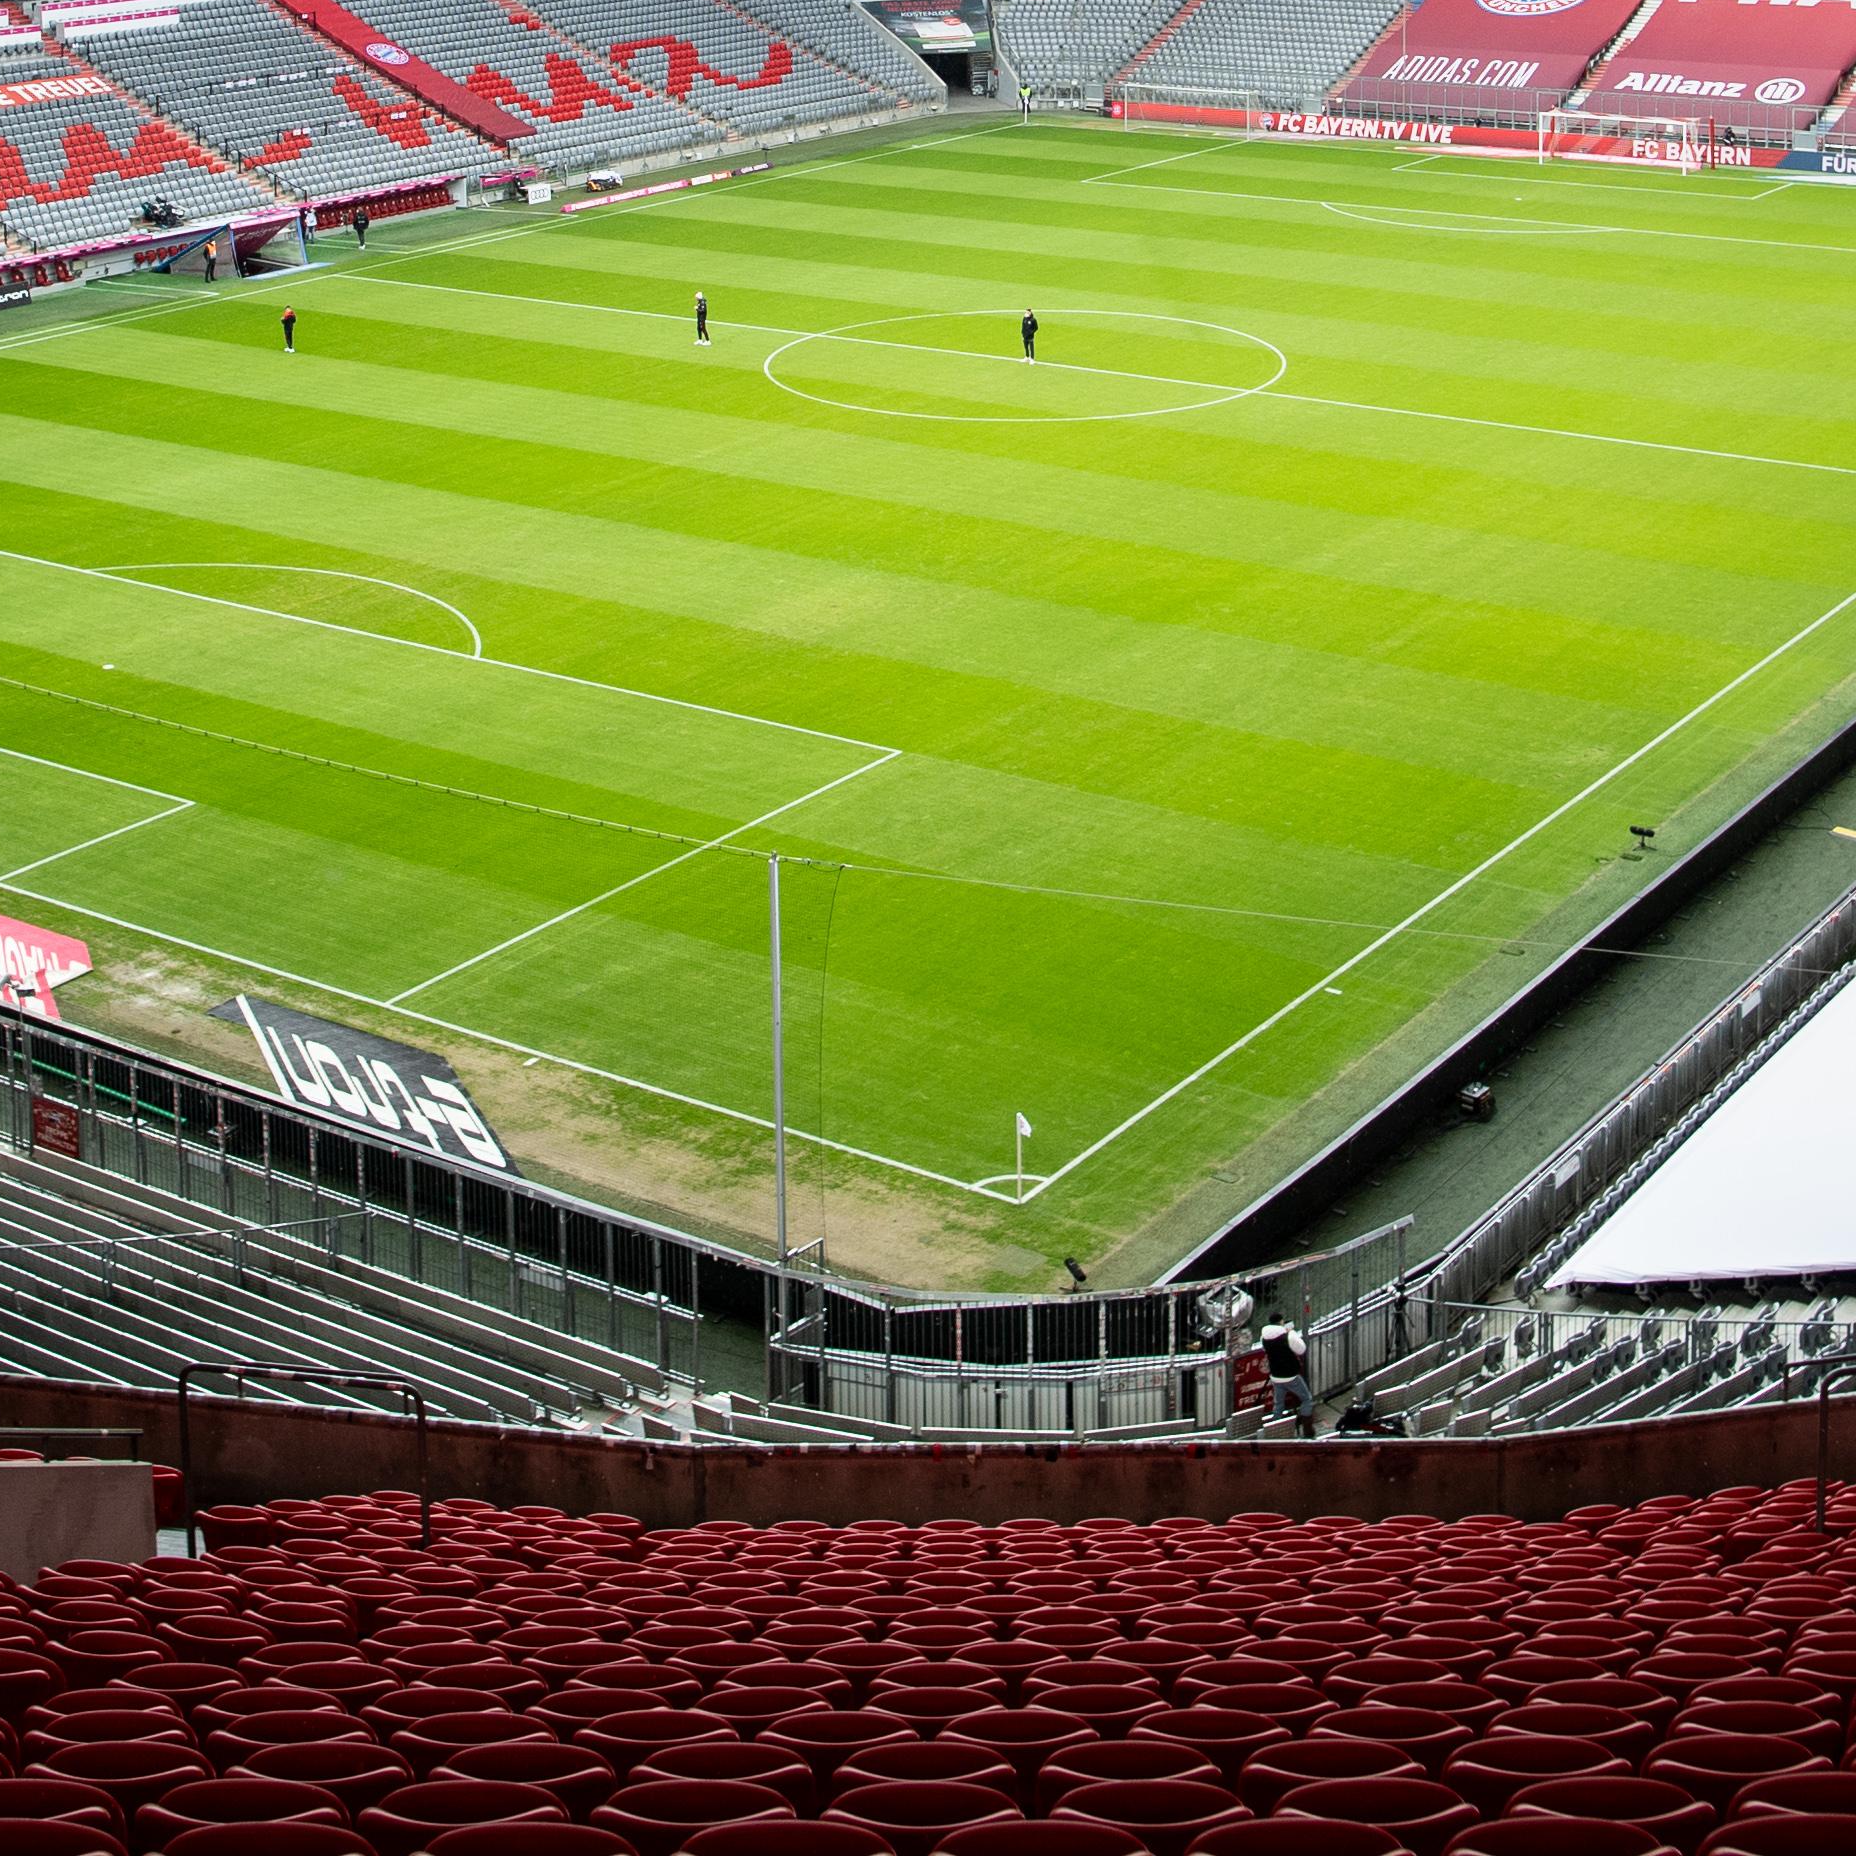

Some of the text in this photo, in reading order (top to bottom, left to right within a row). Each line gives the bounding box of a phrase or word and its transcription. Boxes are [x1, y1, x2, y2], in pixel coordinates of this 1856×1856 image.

[1383, 54, 1540, 88] ADIDAS.COM
[1612, 70, 1748, 99] Allianz
[15, 75, 112, 106] TREUE!
[1277, 113, 1454, 143] FC BAYERN.TV LIVE
[1632, 139, 1752, 165] FC BAYERN
